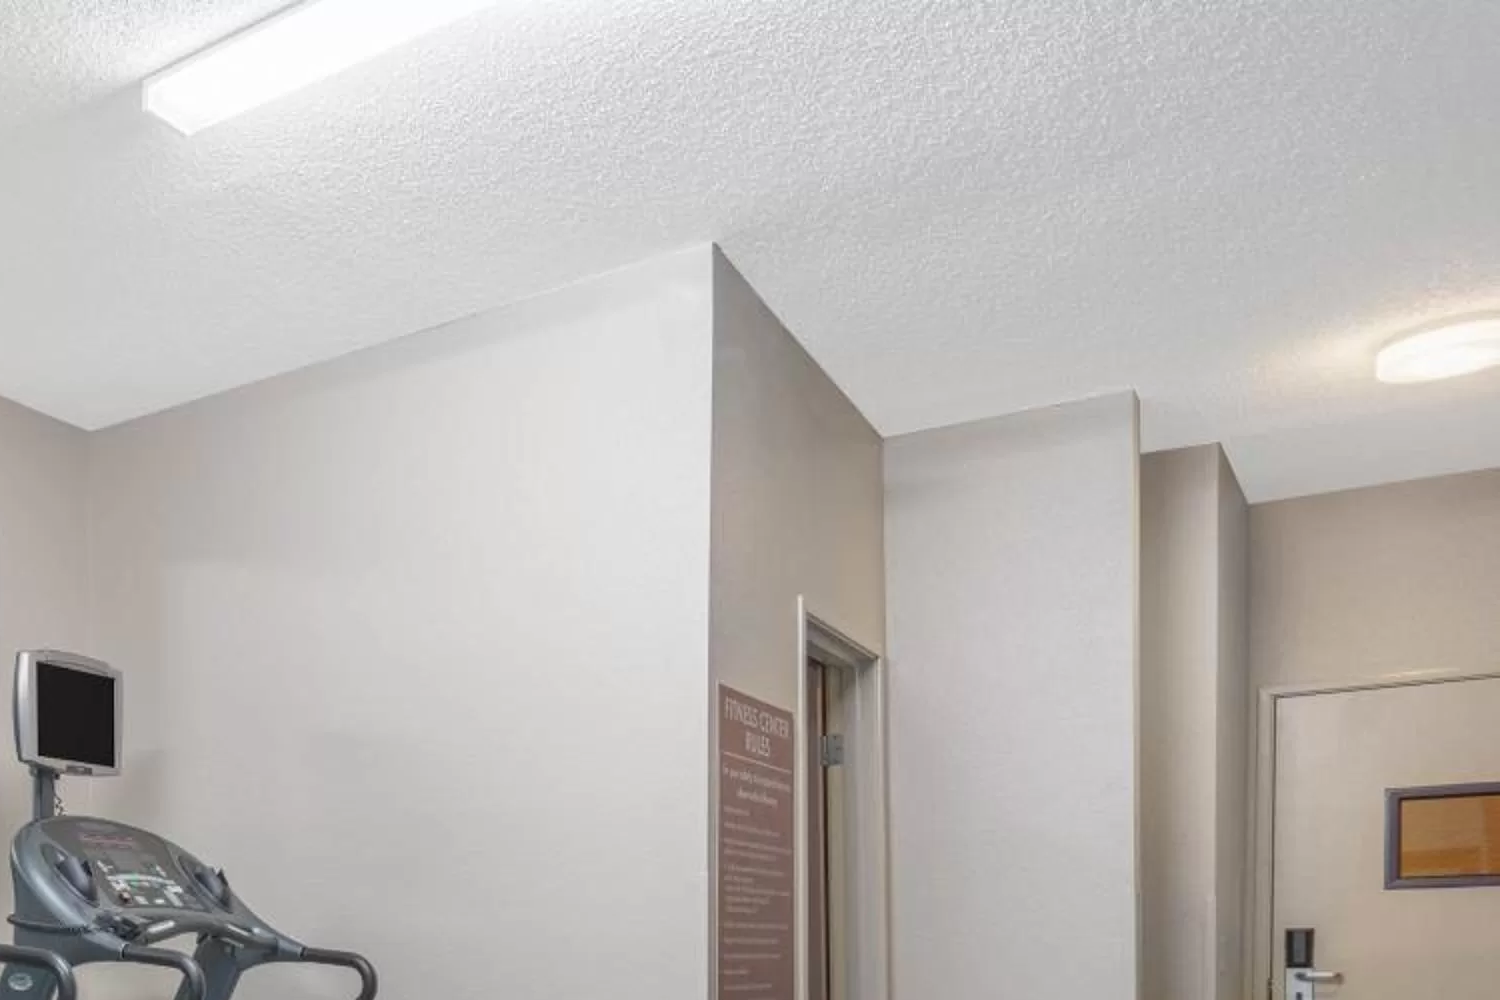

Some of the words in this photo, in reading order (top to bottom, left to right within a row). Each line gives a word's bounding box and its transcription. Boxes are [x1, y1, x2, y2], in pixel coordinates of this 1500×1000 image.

[723, 695, 758, 729] FITNESS
[759, 711, 789, 738] CENTER
[745, 731, 770, 757] RULES
